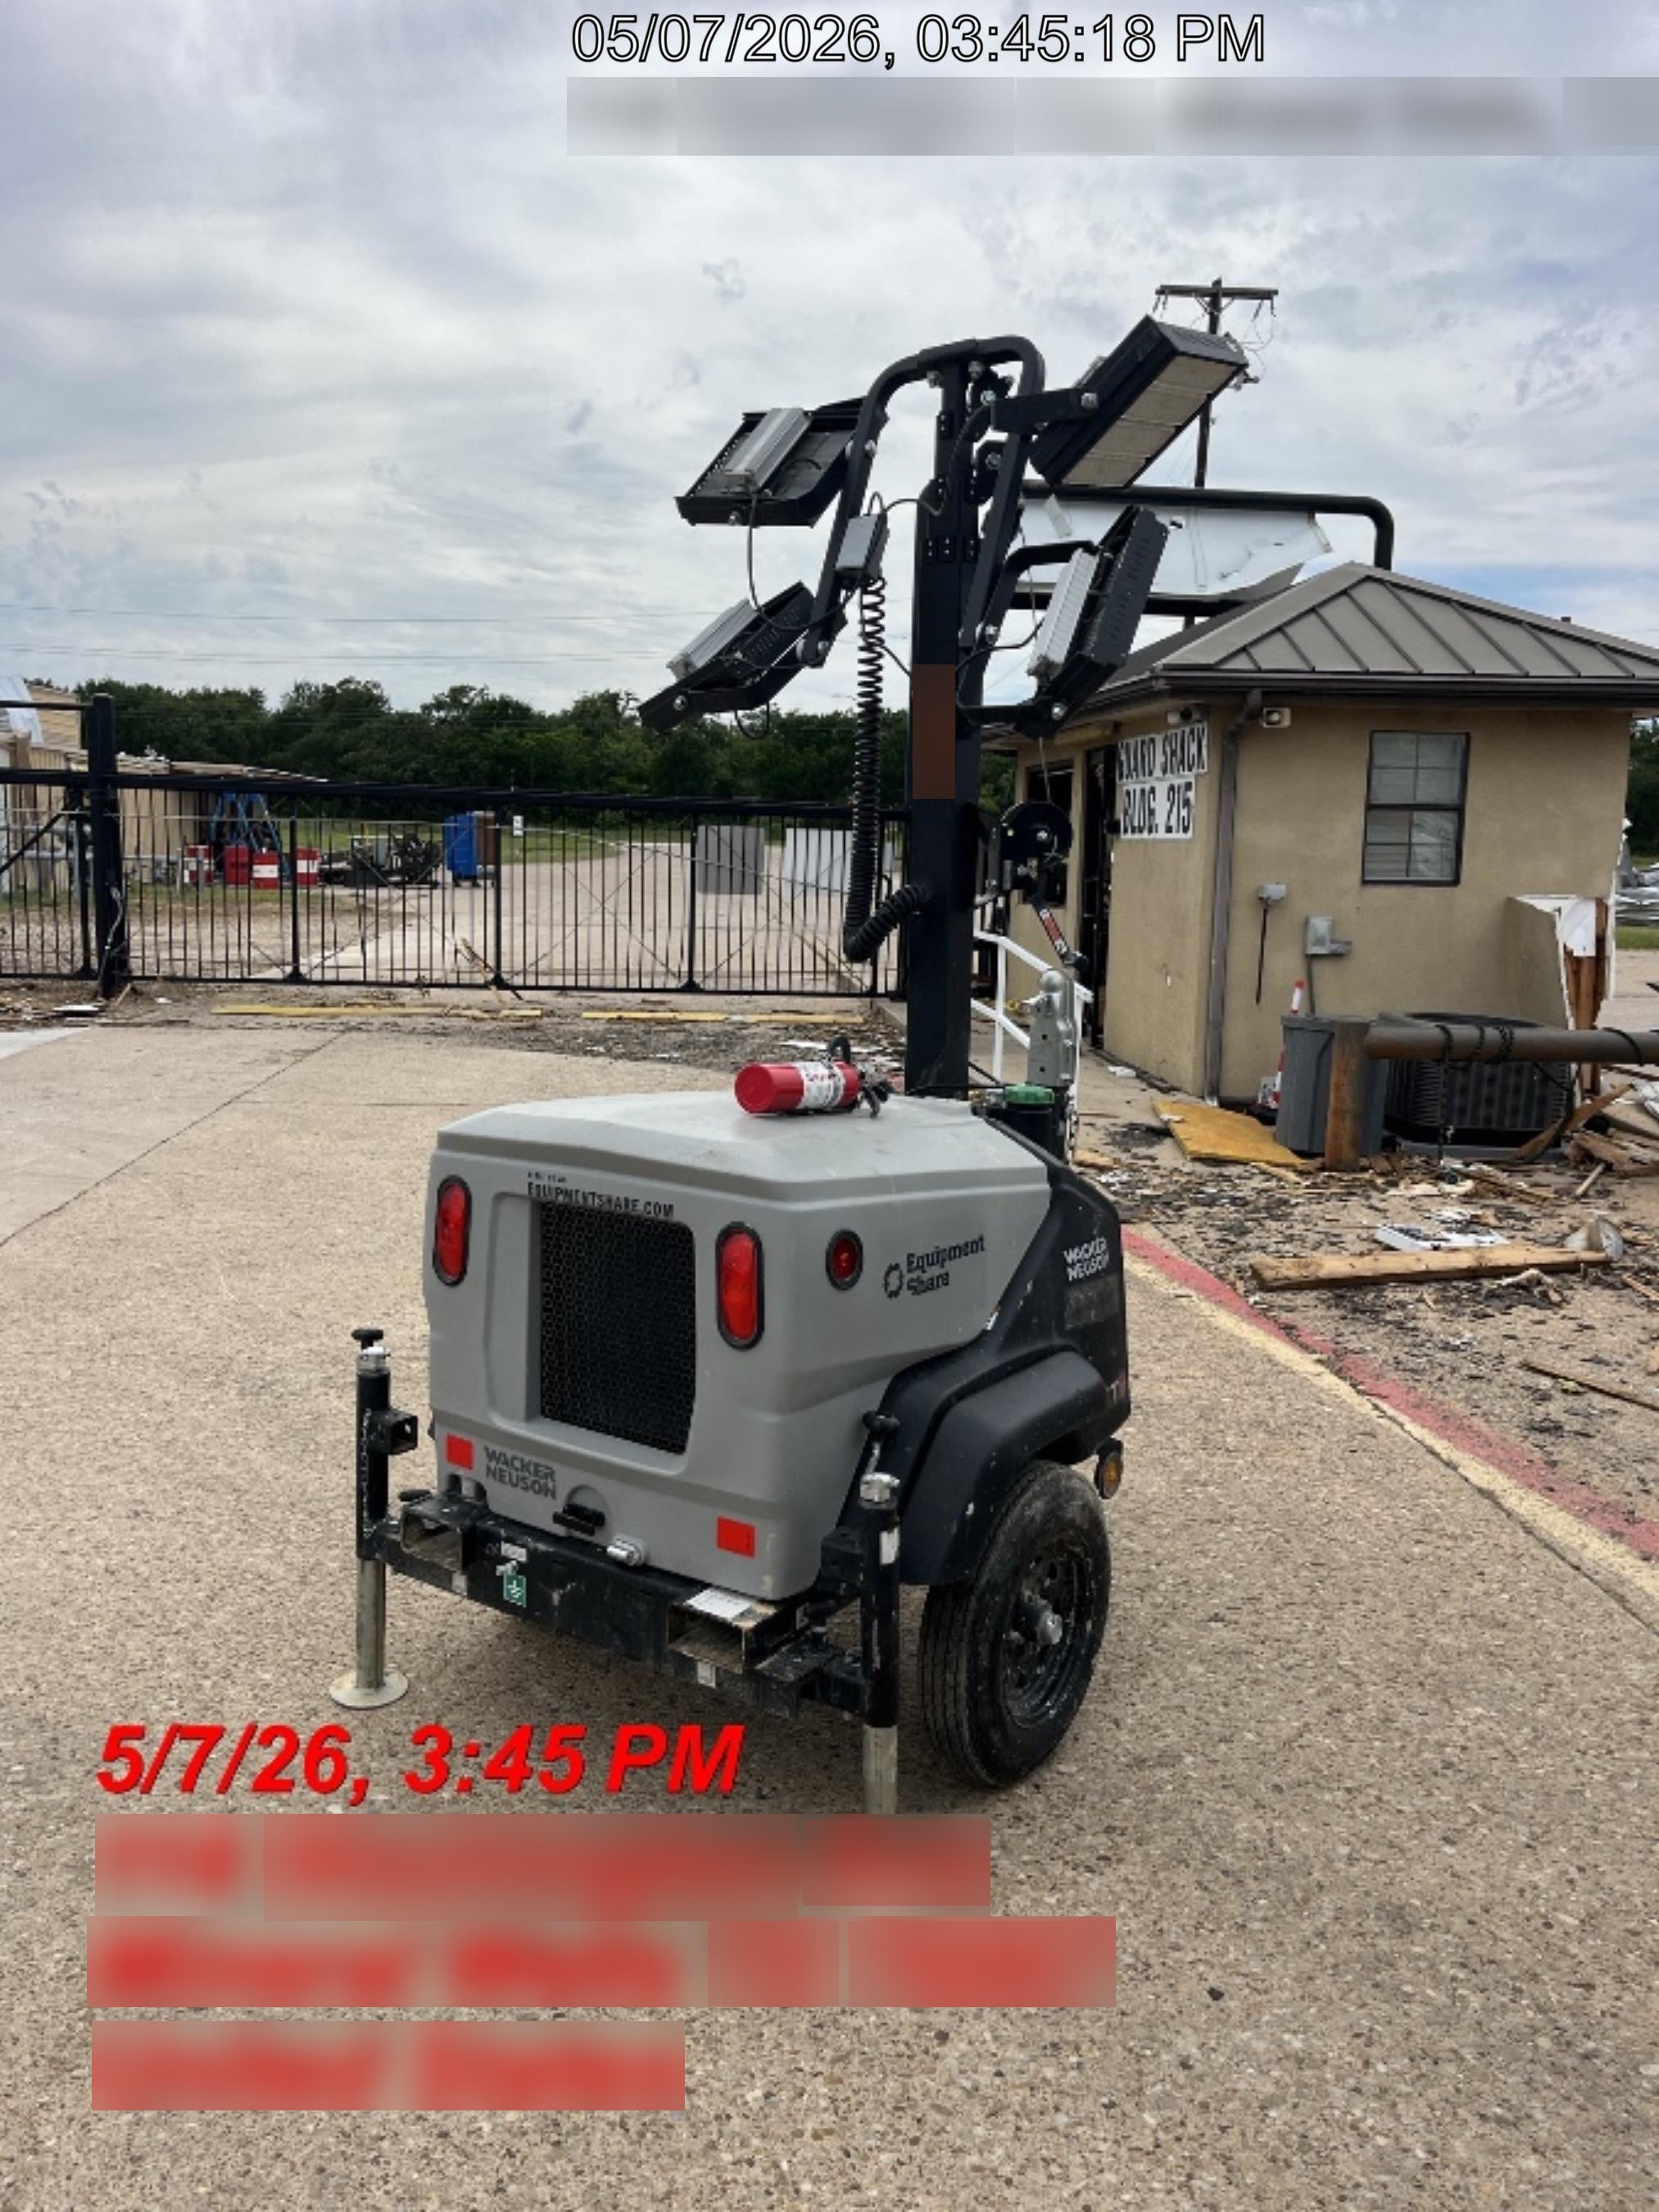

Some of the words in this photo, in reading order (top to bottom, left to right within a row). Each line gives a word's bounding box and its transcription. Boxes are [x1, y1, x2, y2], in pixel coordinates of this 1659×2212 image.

[1160, 726, 1205, 777] SHACK
[1164, 782, 1193, 834] 215
[906, 1234, 986, 1273] Equipment
[906, 1271, 950, 1296] Share
[484, 1446, 556, 1482] WACKER
[486, 1464, 557, 1500] NEUSON
